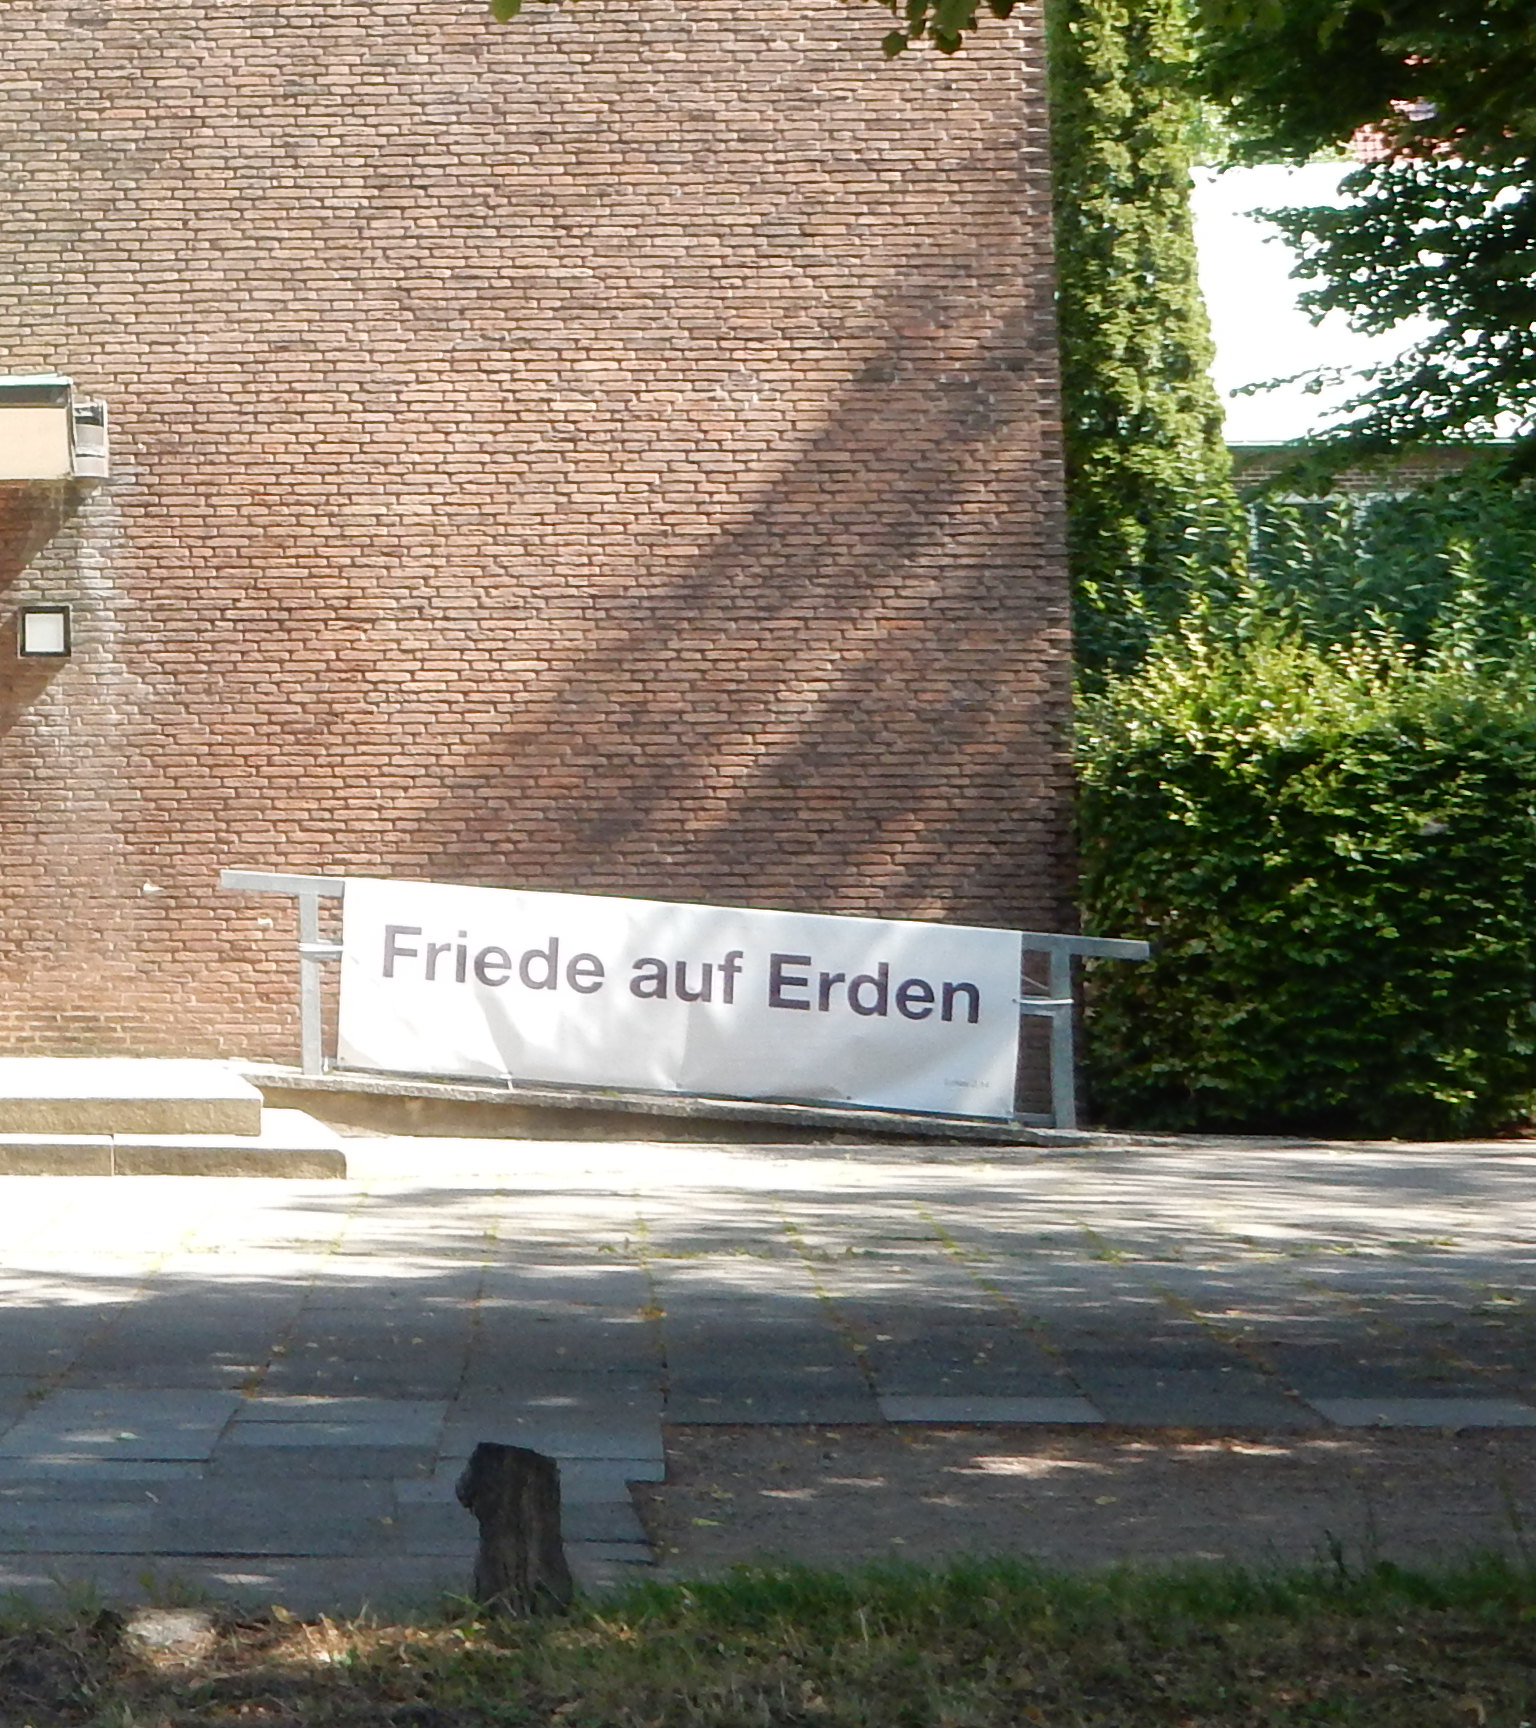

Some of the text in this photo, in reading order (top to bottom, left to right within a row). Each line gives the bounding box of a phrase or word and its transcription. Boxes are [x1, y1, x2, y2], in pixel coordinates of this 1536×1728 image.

[382, 924, 980, 1024] Friede auf Erden
